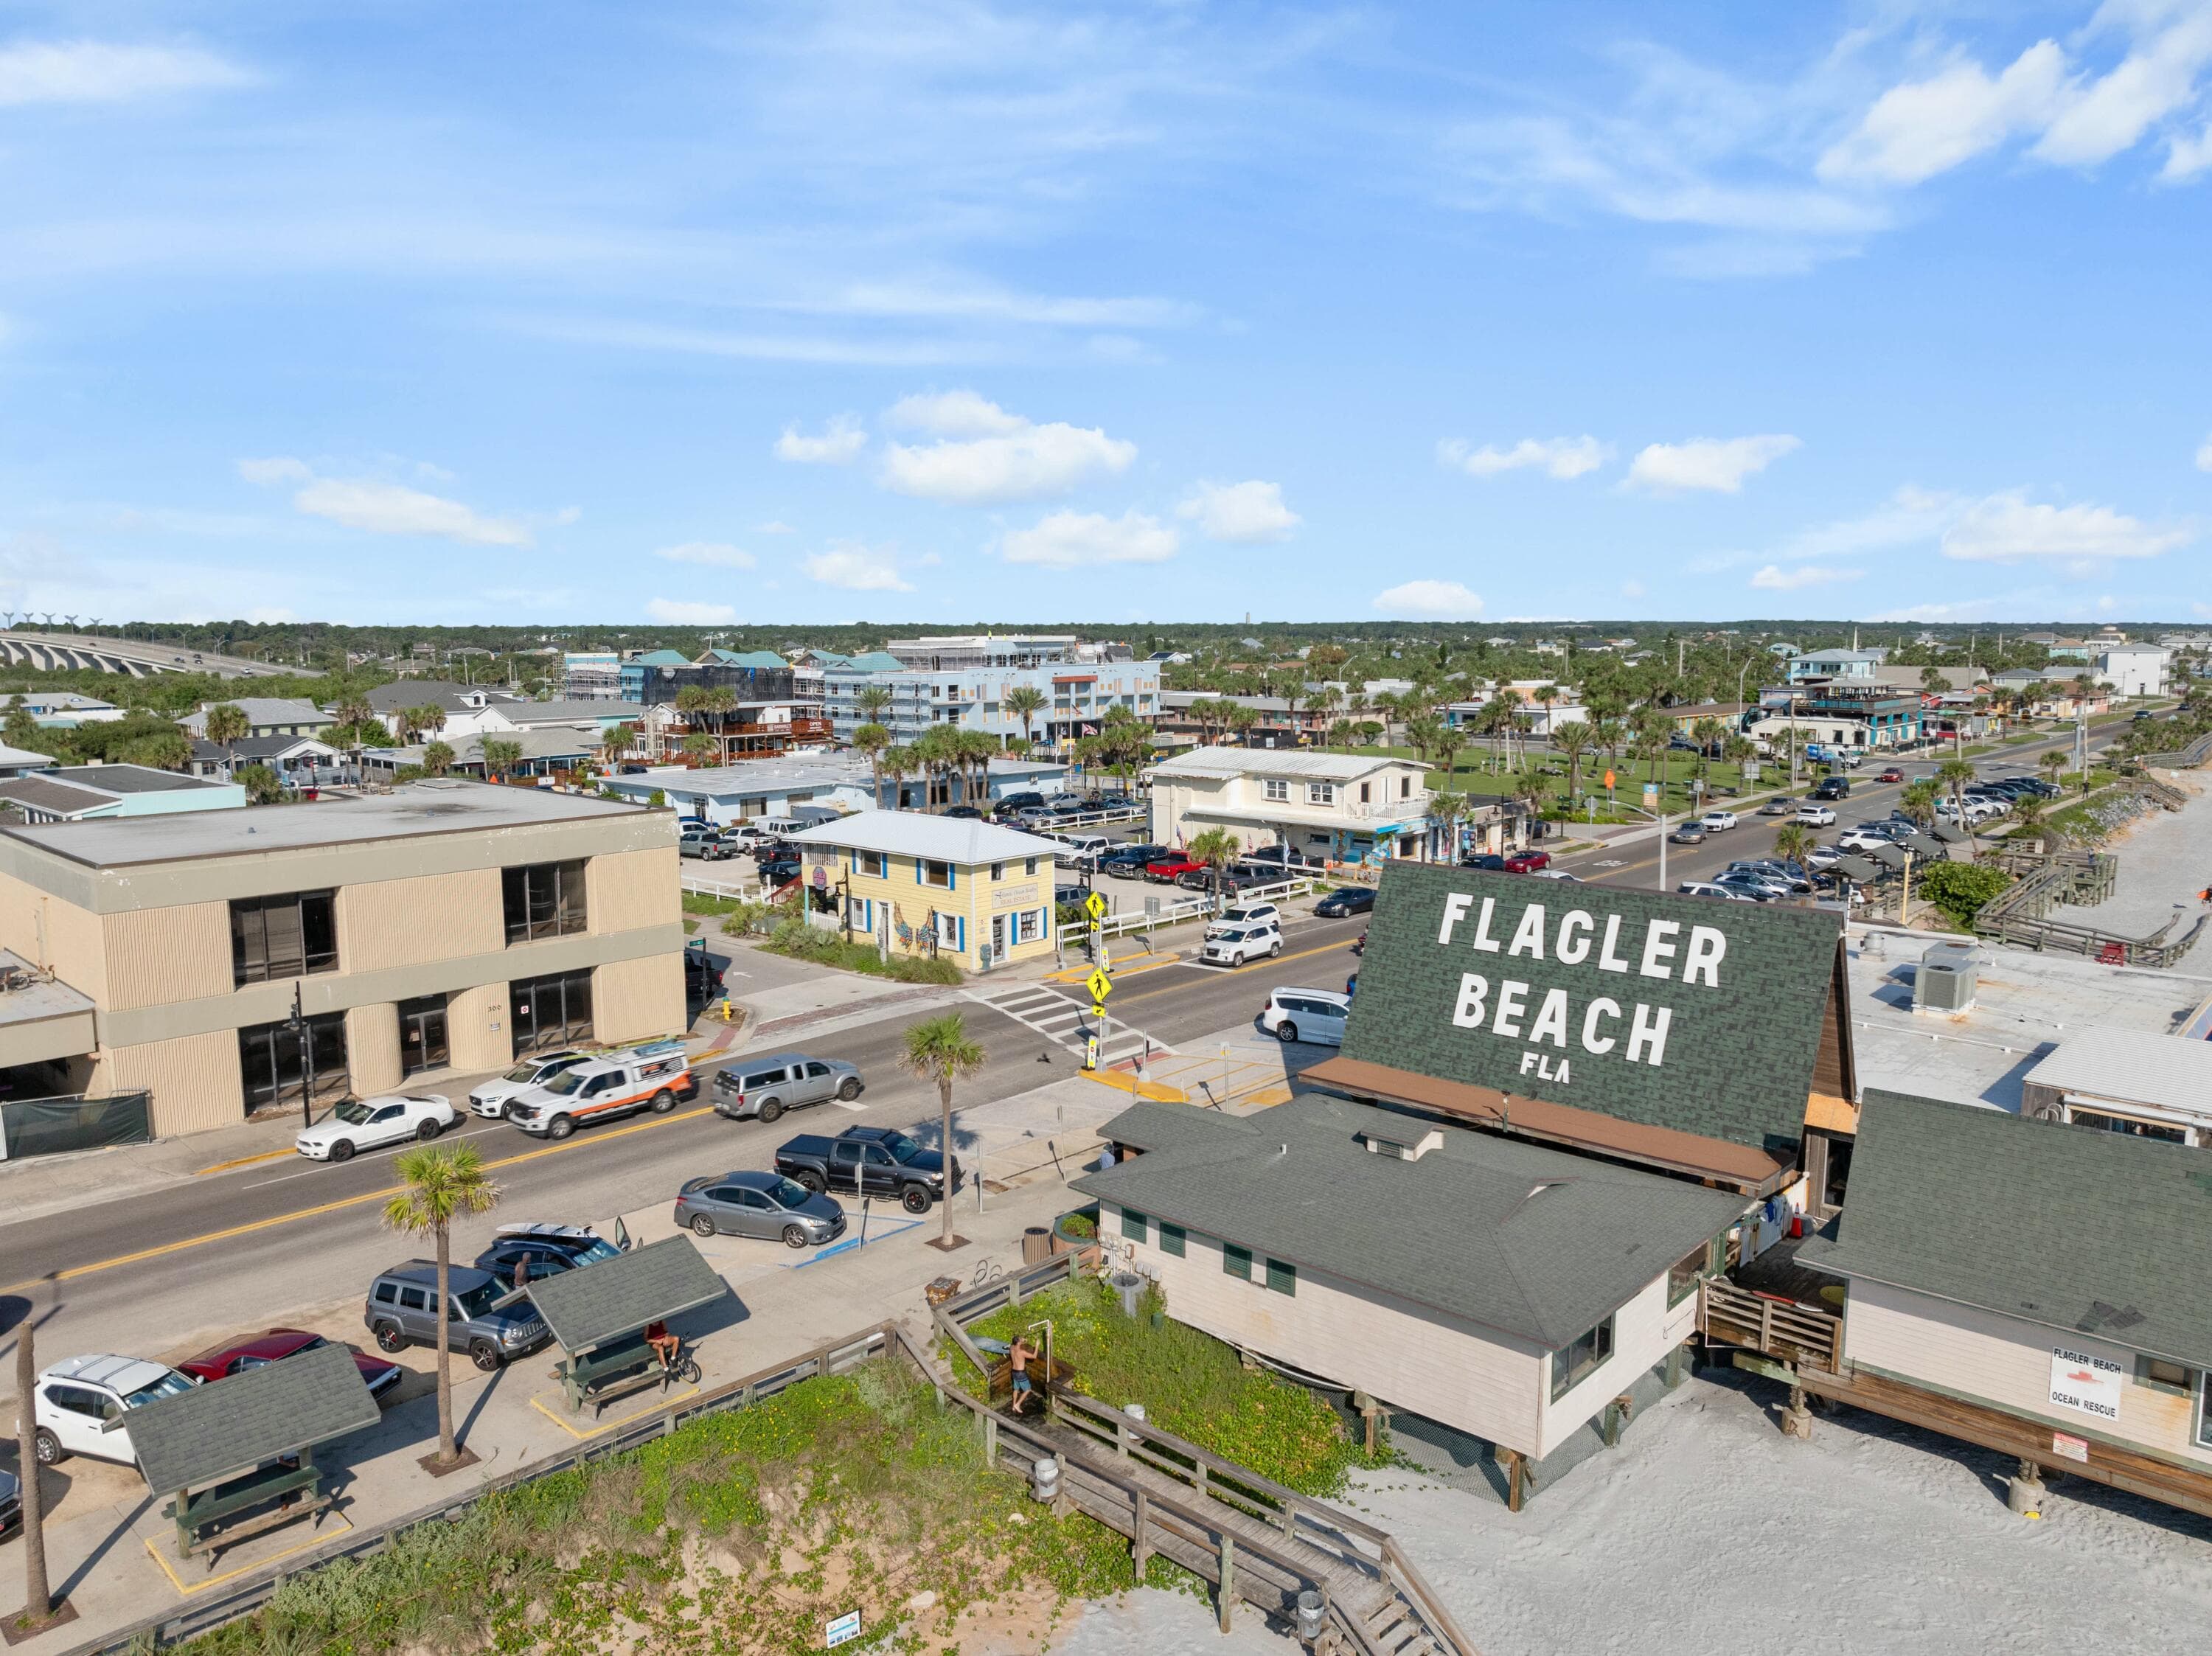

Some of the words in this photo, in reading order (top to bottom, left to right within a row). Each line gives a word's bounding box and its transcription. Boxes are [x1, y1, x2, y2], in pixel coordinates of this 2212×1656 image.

[1000, 897, 1012, 905] REAL
[1013, 894, 1031, 903] ESTATE
[1438, 892, 1727, 988] FLAGLER
[487, 1004, 501, 1012] 300
[1452, 972, 1672, 1067] BEACH
[1519, 1051, 1570, 1084] FLA
[2053, 1348, 2089, 1365] FLAGLER
[2093, 1358, 2121, 1374] BEACH
[2052, 1391, 2079, 1407] OCEAN
[2084, 1400, 2116, 1417] RESCUE
